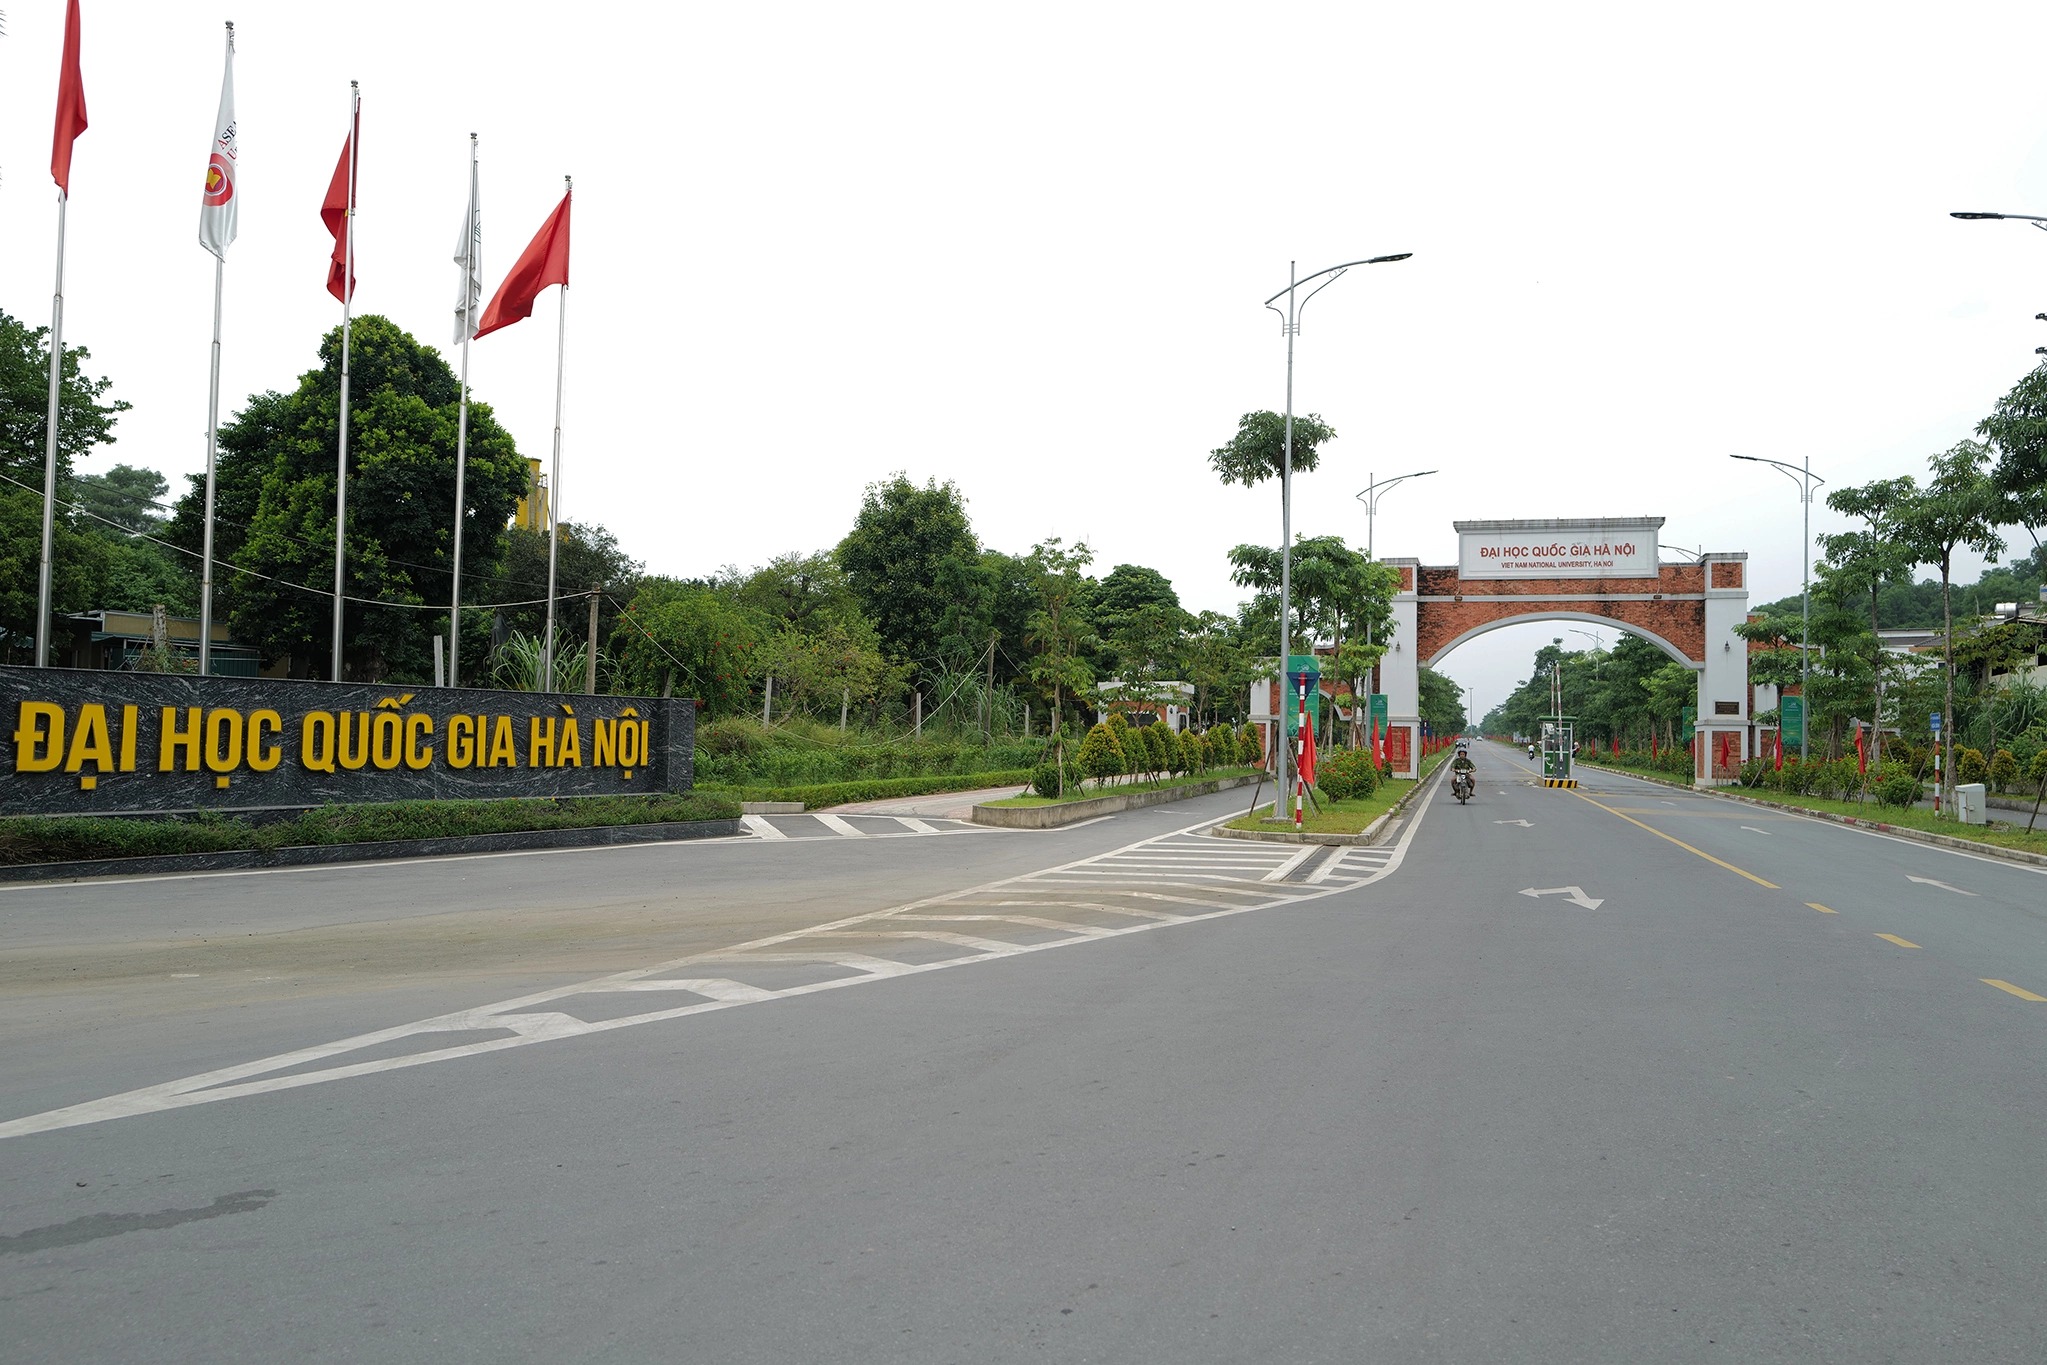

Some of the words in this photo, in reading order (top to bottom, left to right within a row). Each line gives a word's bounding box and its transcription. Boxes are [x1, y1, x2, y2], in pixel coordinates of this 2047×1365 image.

[1480, 547, 1500, 559] ĐẠI
[1503, 546, 1529, 559] HỌC
[1532, 543, 1567, 557] QUỐC
[1570, 545, 1591, 556] GIA
[1594, 543, 1611, 556] HÀ
[1614, 543, 1635, 557] NỘI
[1528, 561, 1557, 569] NATIONAL
[1558, 560, 1593, 568] UNIVERSITY,
[14, 700, 138, 790] ĐẠI
[158, 706, 283, 789] HỌC
[301, 693, 433, 774] QUỐC
[447, 713, 517, 769] GIA
[529, 704, 582, 768] HÀ
[593, 707, 649, 780] NỘI
